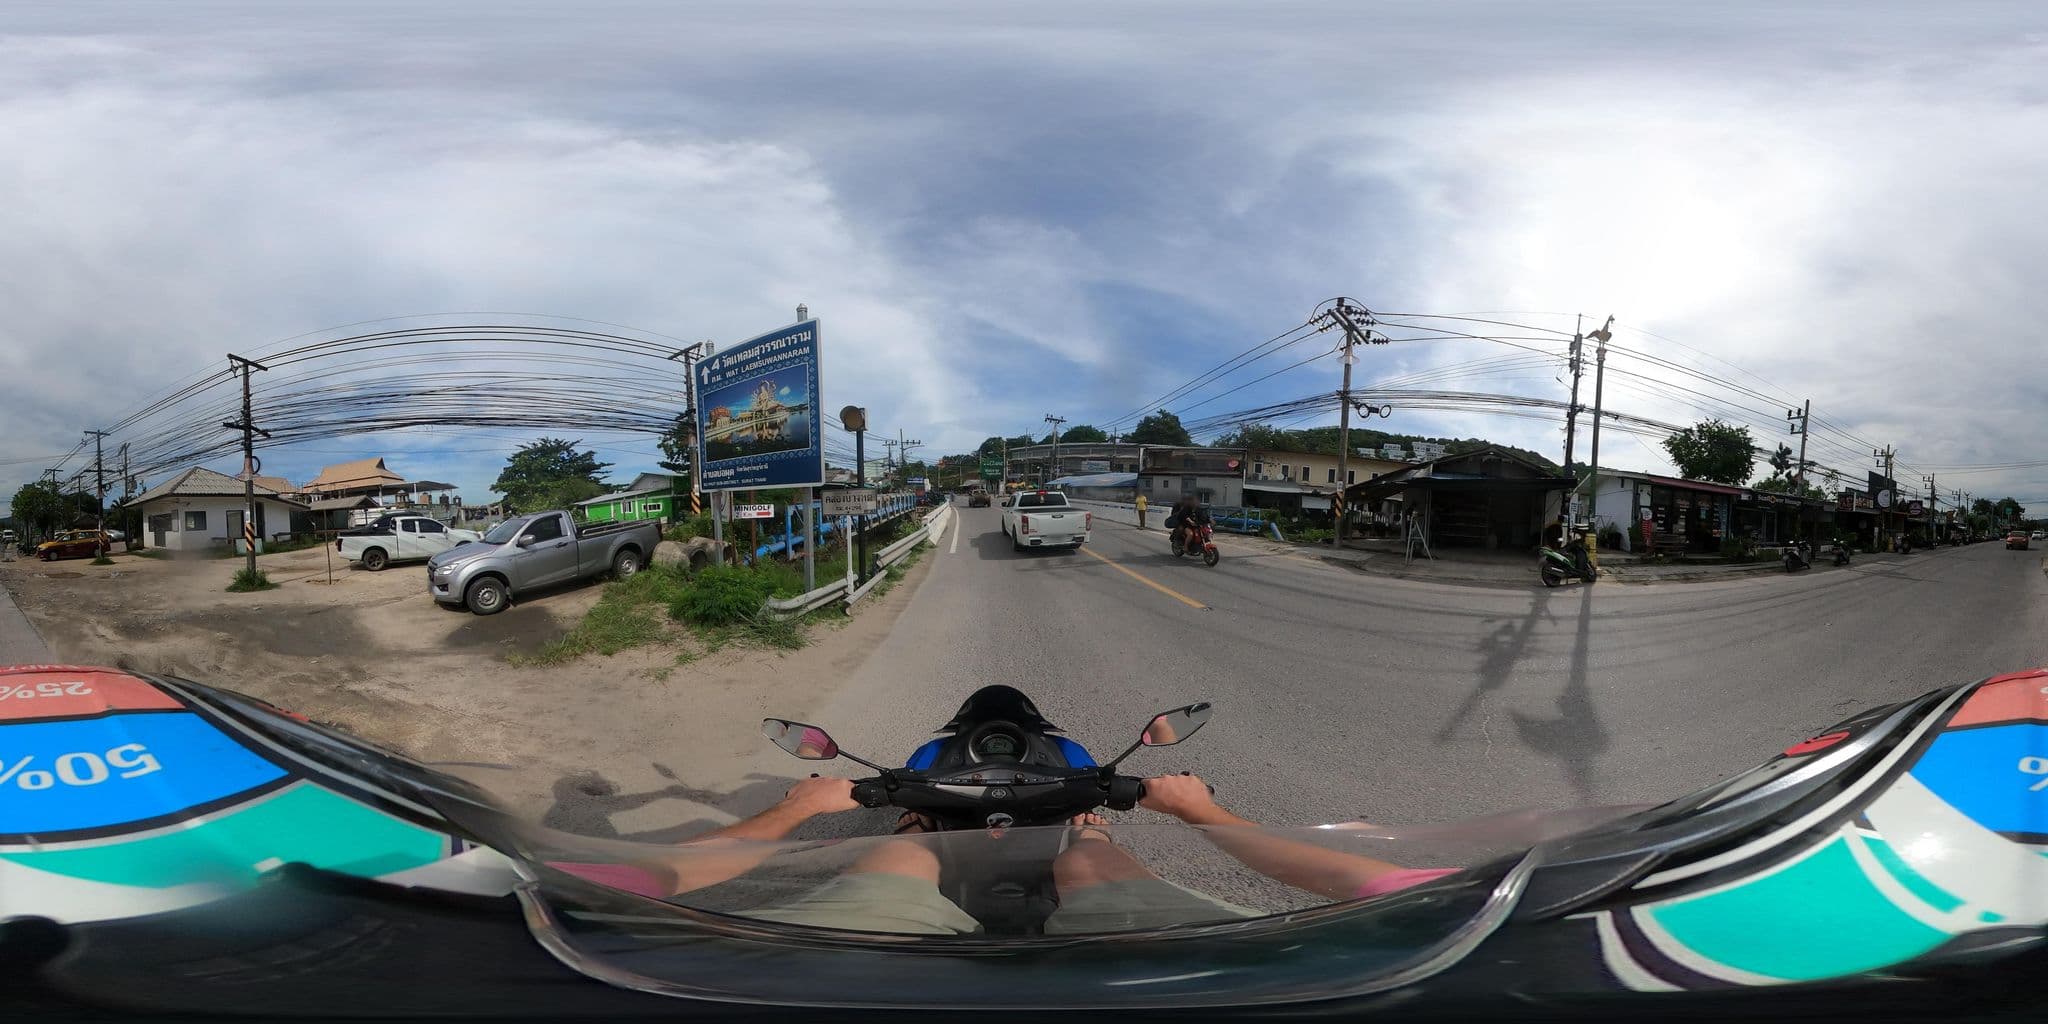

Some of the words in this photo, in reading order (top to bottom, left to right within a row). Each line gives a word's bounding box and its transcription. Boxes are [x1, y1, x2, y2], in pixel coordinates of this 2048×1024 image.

[711, 359, 720, 370] 4
[722, 330, 811, 368] วัดแหลมสุวรรณาราม
[726, 369, 738, 378] WAT
[741, 347, 809, 373] LAEMSUWANNARAM
[0, 743, 162, 790] 50%
